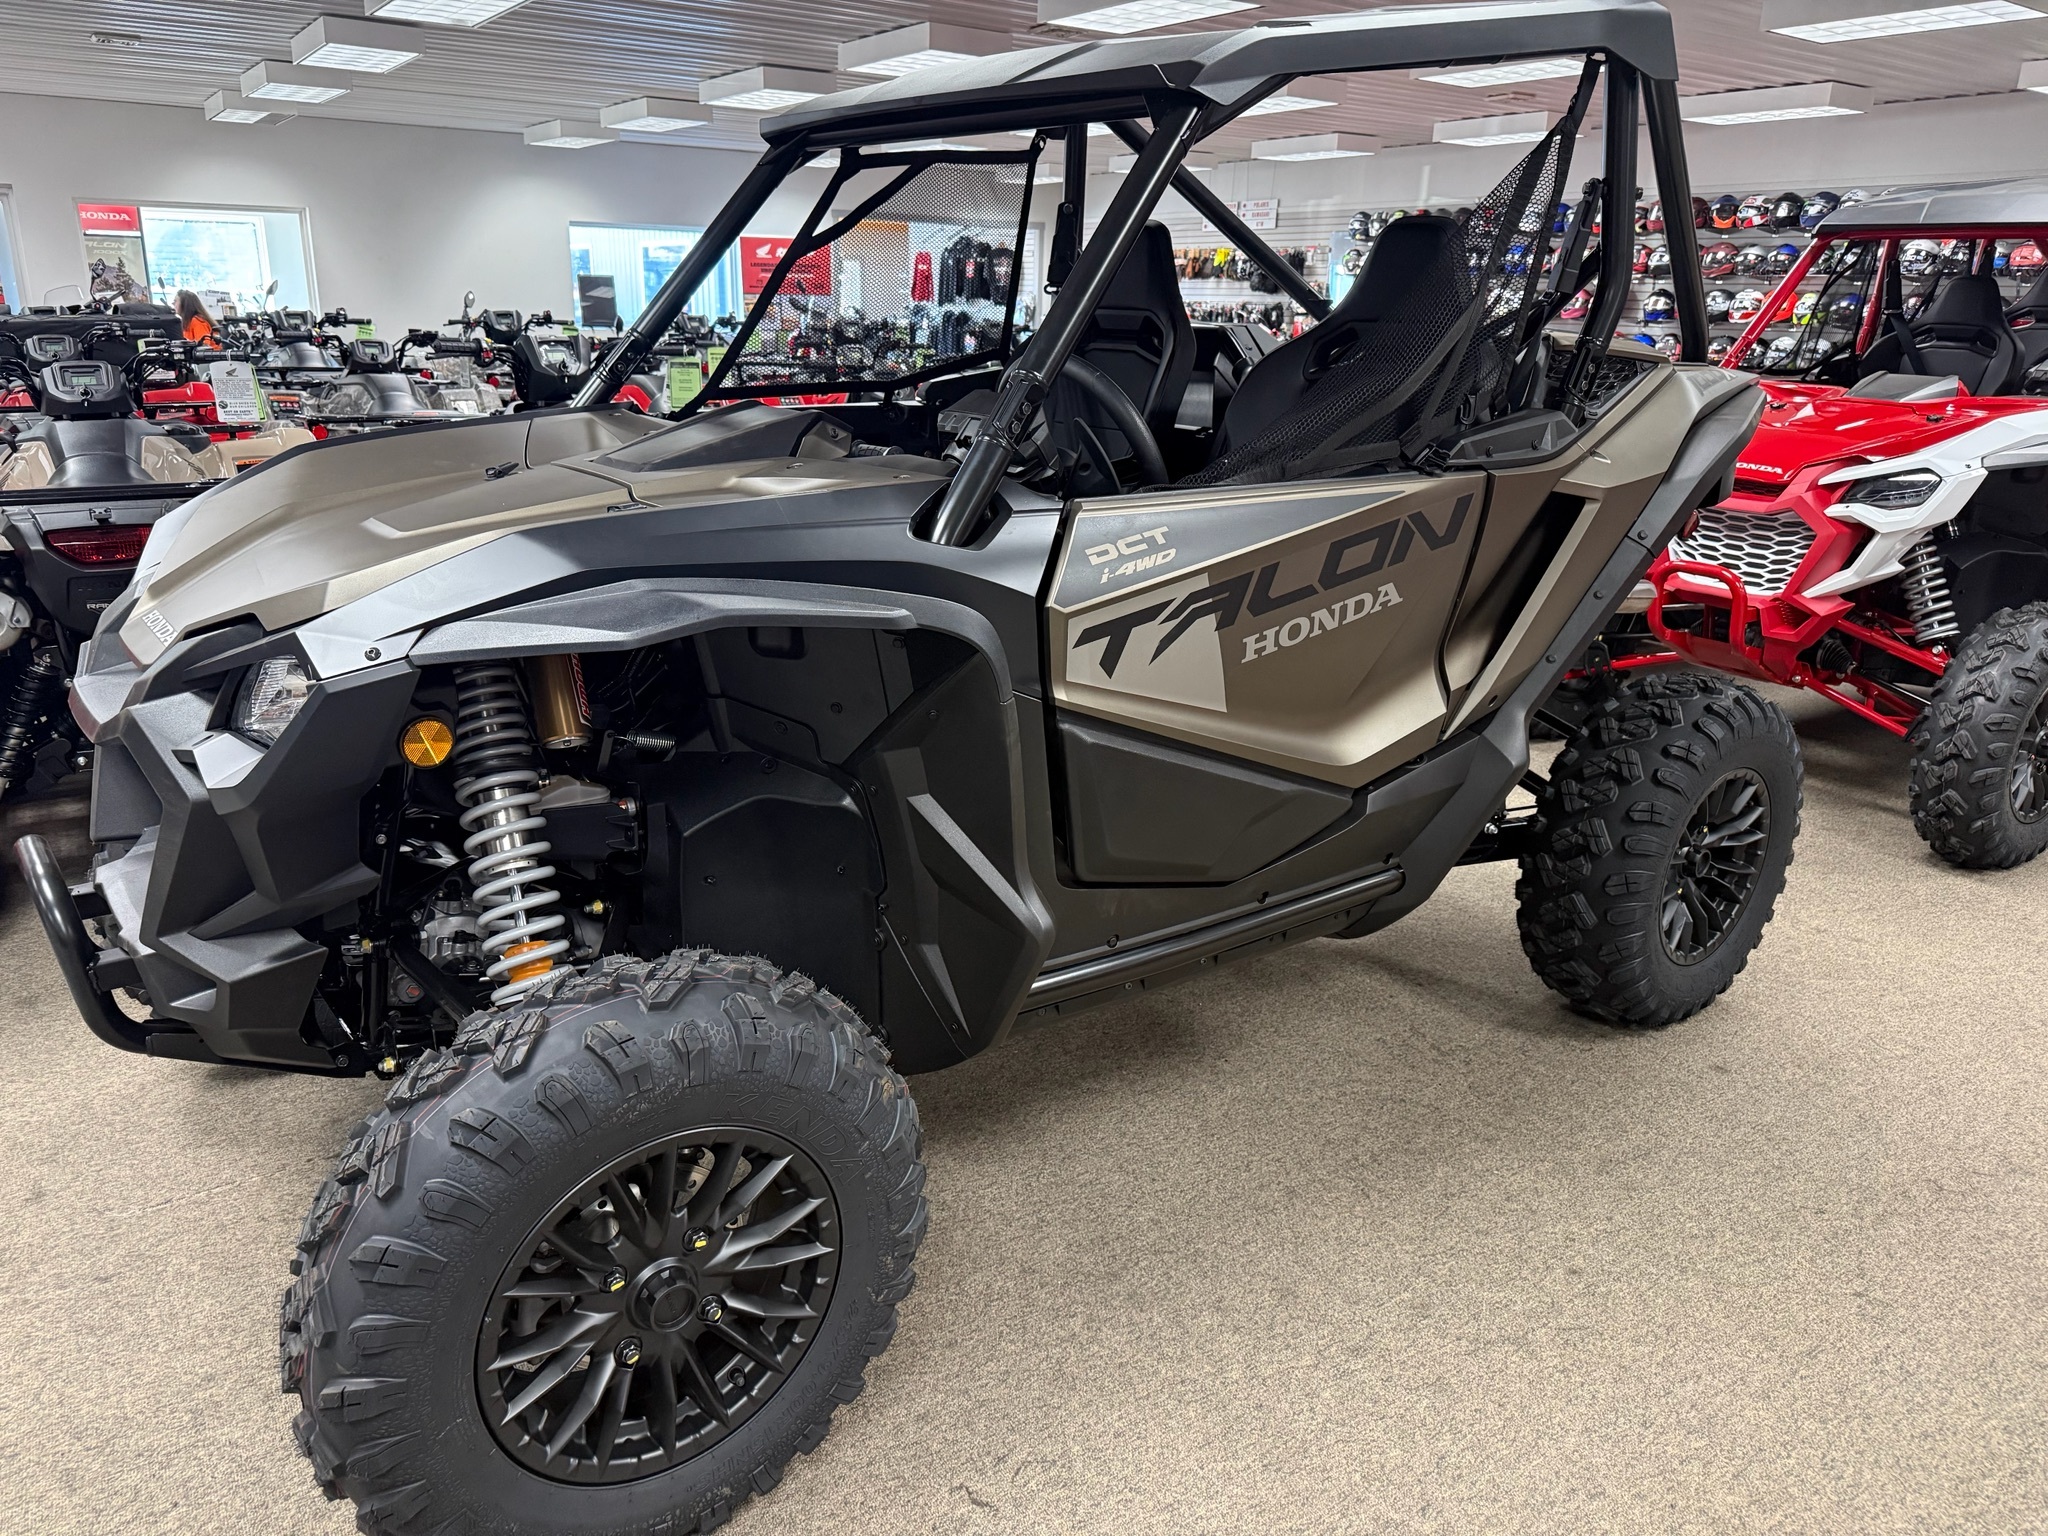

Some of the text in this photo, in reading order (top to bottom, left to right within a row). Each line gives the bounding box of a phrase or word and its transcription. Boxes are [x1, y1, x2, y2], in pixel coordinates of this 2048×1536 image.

[1085, 526, 1169, 566] DCT
[1100, 548, 1177, 584] i-4WD
[1071, 493, 1475, 680] TALON
[142, 609, 178, 646] HONDA
[1241, 582, 1403, 664] HONDA
[709, 1092, 866, 1187] KENDA
